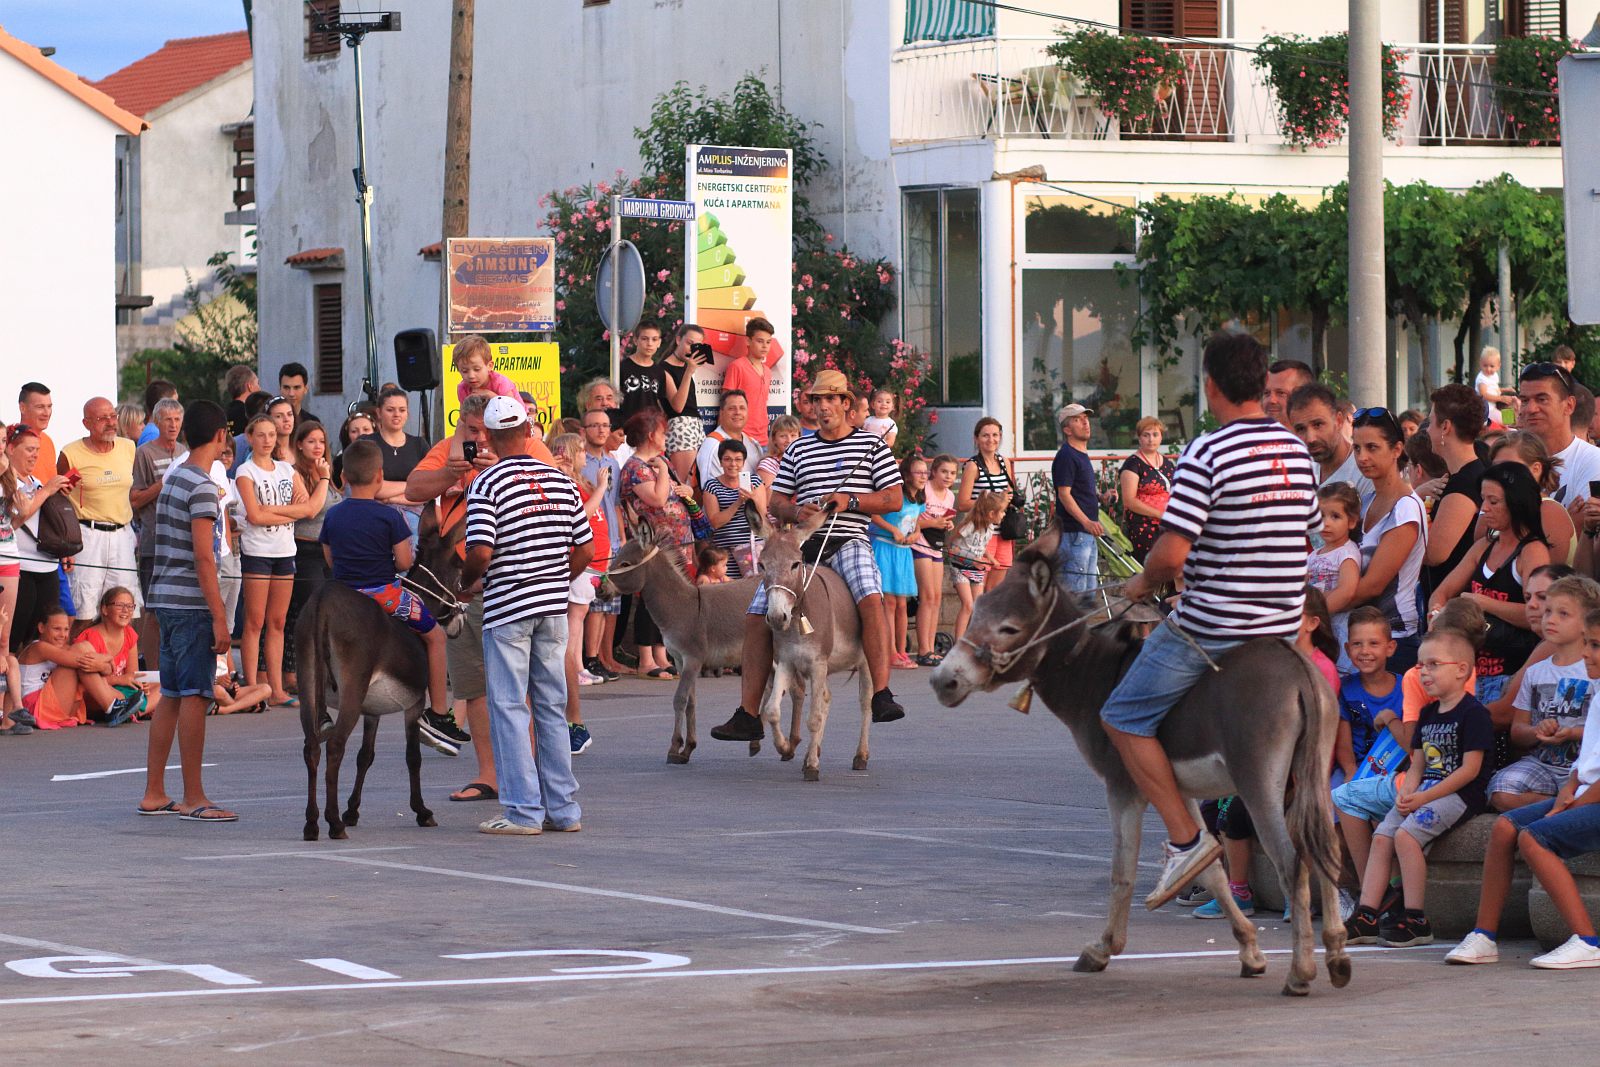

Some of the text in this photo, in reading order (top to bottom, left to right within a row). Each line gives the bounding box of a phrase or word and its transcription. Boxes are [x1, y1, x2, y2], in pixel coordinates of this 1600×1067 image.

[697, 182, 788, 194] ENERGETSKI CERTIFIKAT
[623, 200, 694, 219] MARIJANA GRDOVIĆA
[703, 196, 725, 208] KUĆA
[731, 199, 782, 210] APARTMANA
[465, 256, 538, 272] SAMSUNG
[474, 273, 529, 284] SERVIS
[733, 290, 740, 305] E
[493, 356, 542, 371] APARTMANI
[1539, 700, 1572, 714] NEW
